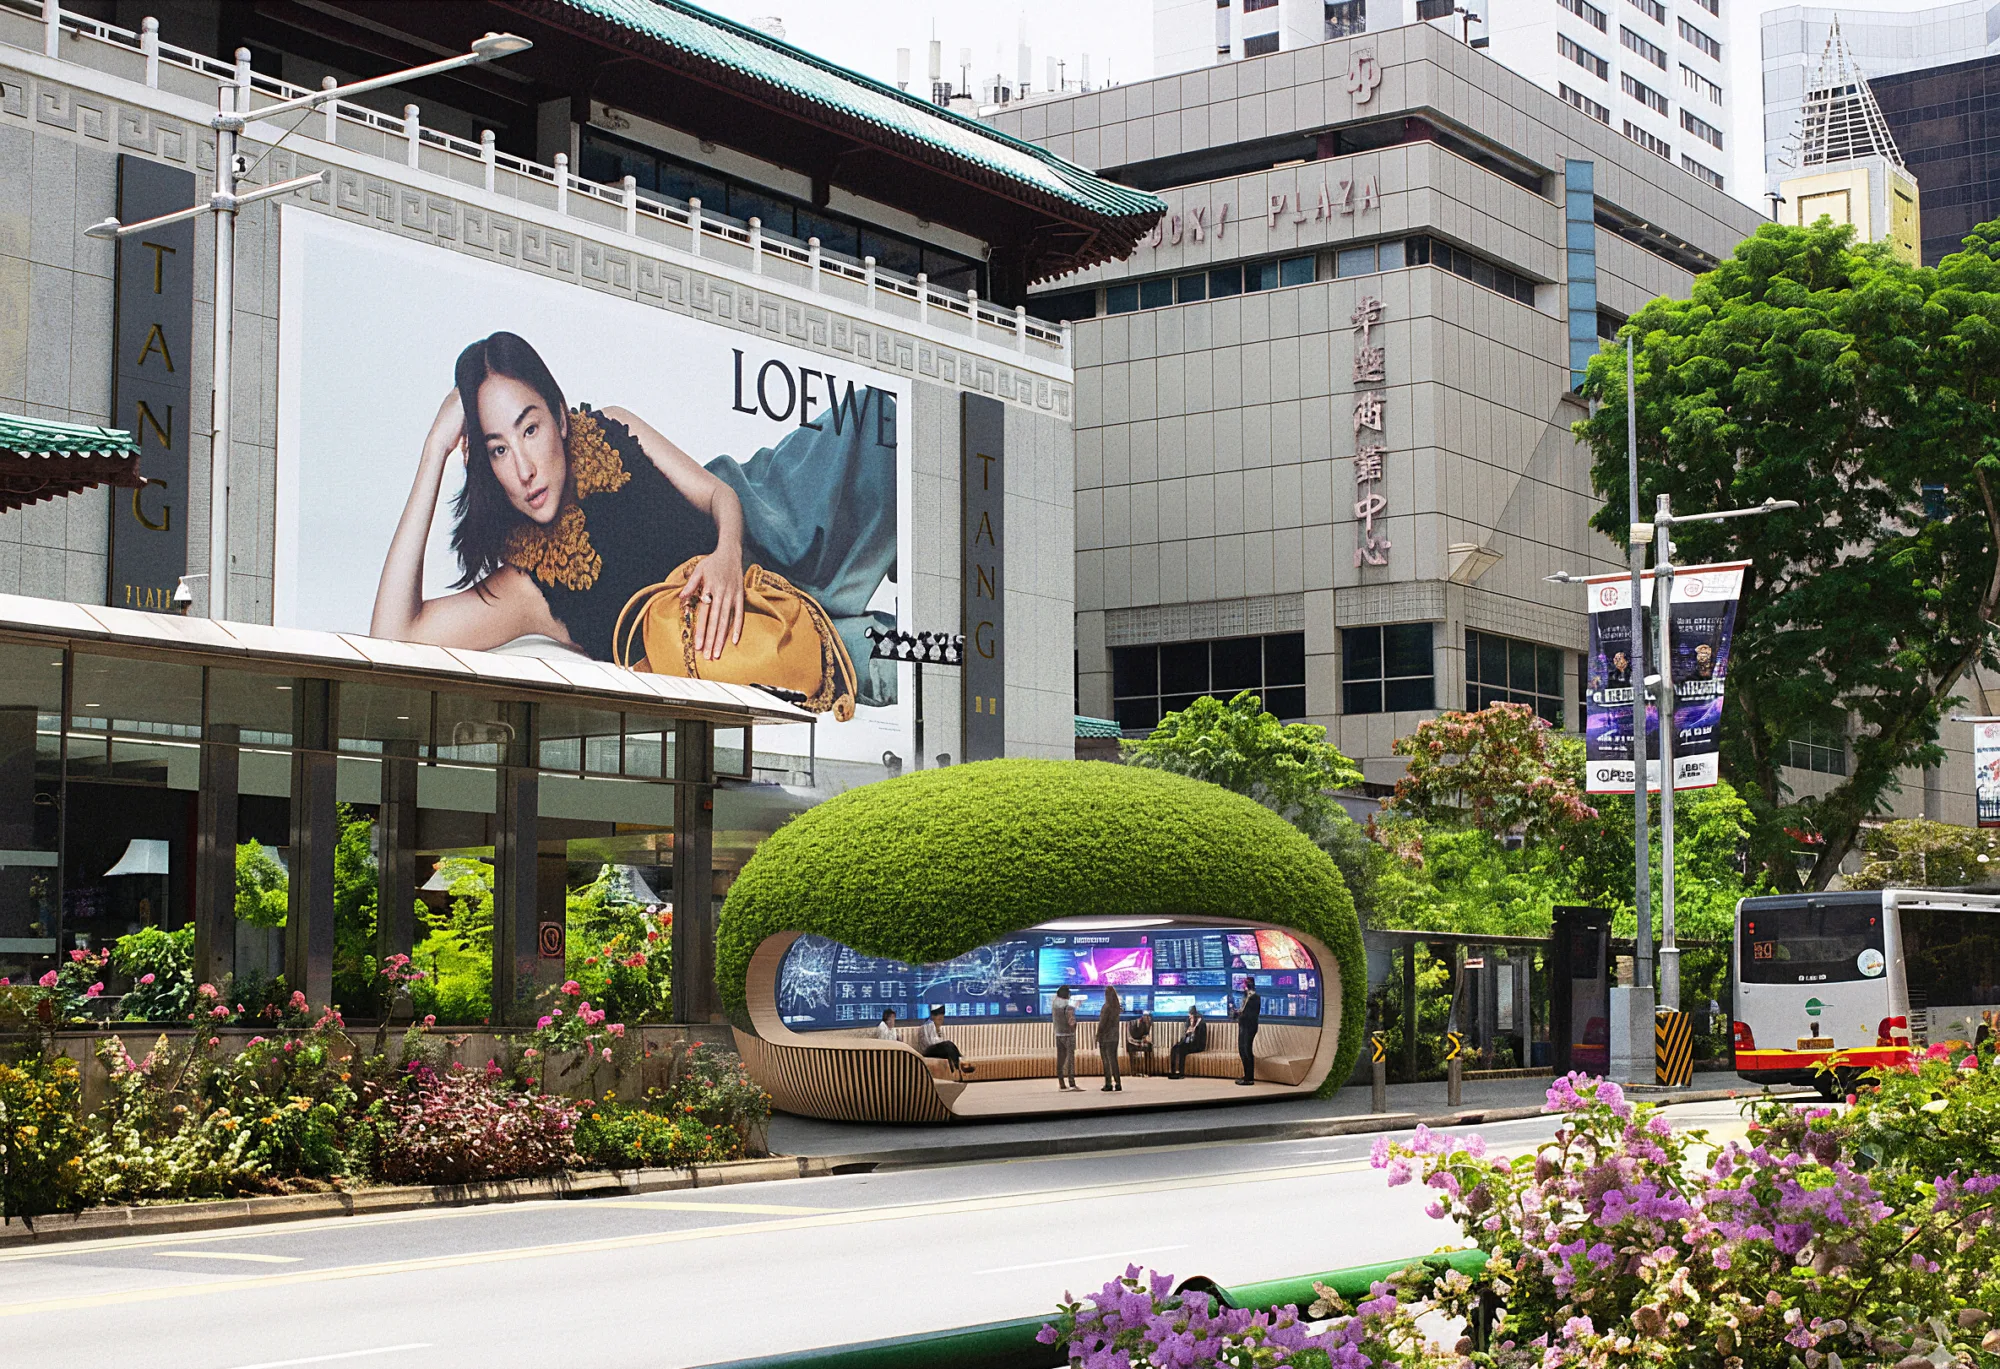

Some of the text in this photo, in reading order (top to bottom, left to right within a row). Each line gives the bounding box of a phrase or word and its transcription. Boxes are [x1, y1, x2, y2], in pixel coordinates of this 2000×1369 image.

[1268, 175, 1381, 229] PLAZA
[132, 241, 177, 532] TANG
[732, 347, 898, 449] LOEWE
[974, 452, 996, 660] TANG
